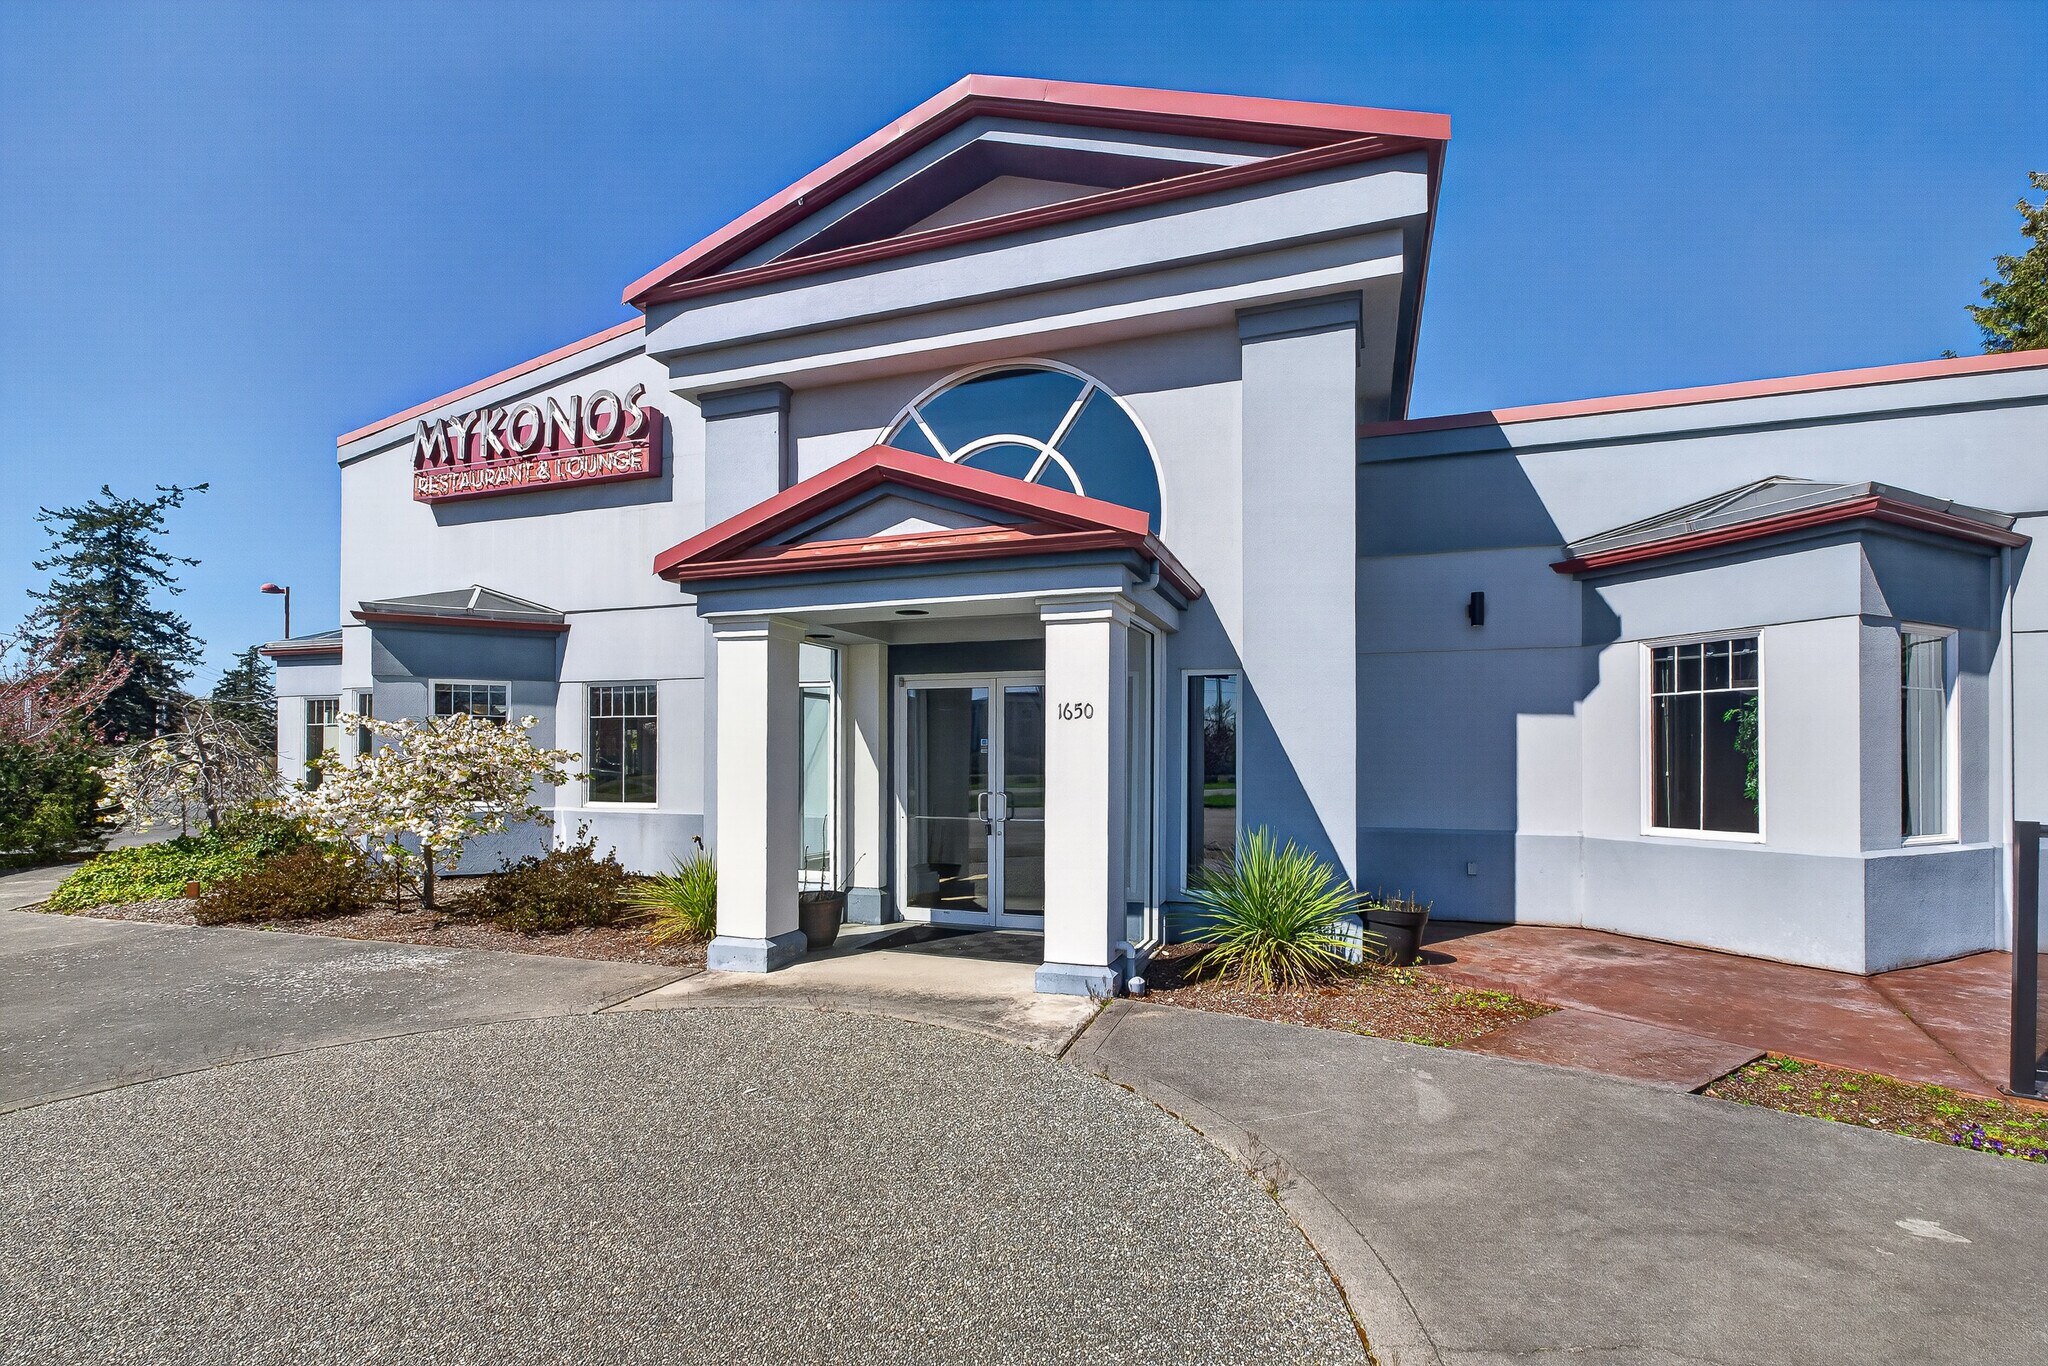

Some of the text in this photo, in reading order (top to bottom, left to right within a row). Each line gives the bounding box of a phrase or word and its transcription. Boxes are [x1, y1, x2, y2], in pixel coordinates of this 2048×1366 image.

[410, 382, 646, 464] MYKONOS
[417, 448, 642, 495] RESTAURANT & LOUNGE
[1057, 702, 1094, 720] 1650
